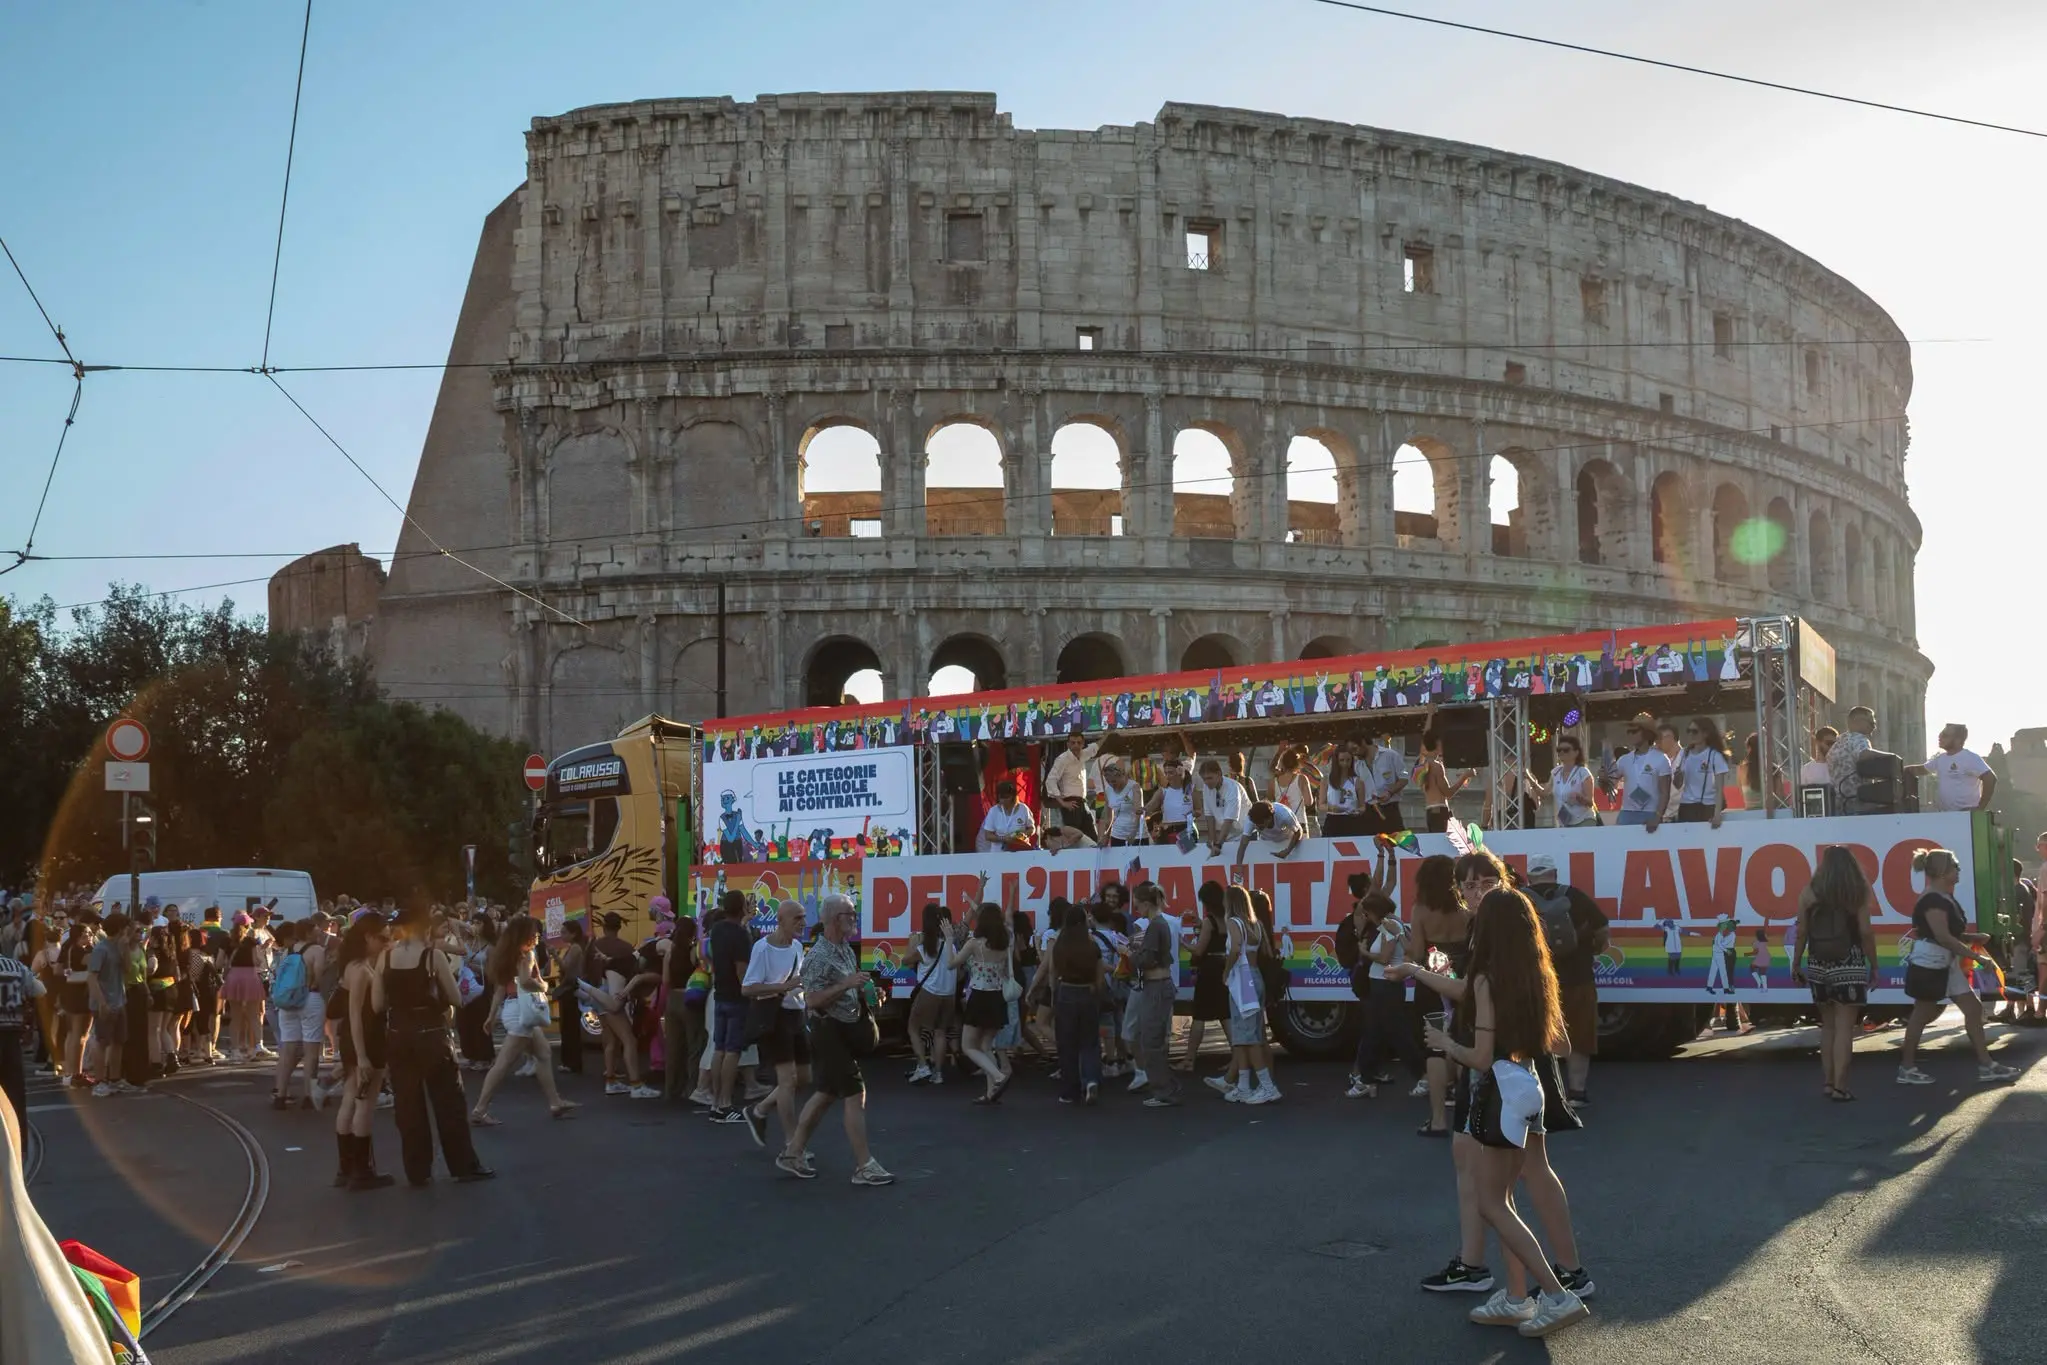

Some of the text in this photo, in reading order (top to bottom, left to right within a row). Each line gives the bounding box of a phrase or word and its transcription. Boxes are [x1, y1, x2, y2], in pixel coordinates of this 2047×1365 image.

[560, 761, 620, 782] COLARUSSO
[778, 764, 877, 785] LE CATEGORIE
[778, 779, 868, 799] LASCIAMOLE
[778, 792, 883, 812] AI CONTRATTI.
[872, 874, 984, 933] PER
[1303, 977, 1351, 985] FILCAMS CGI
